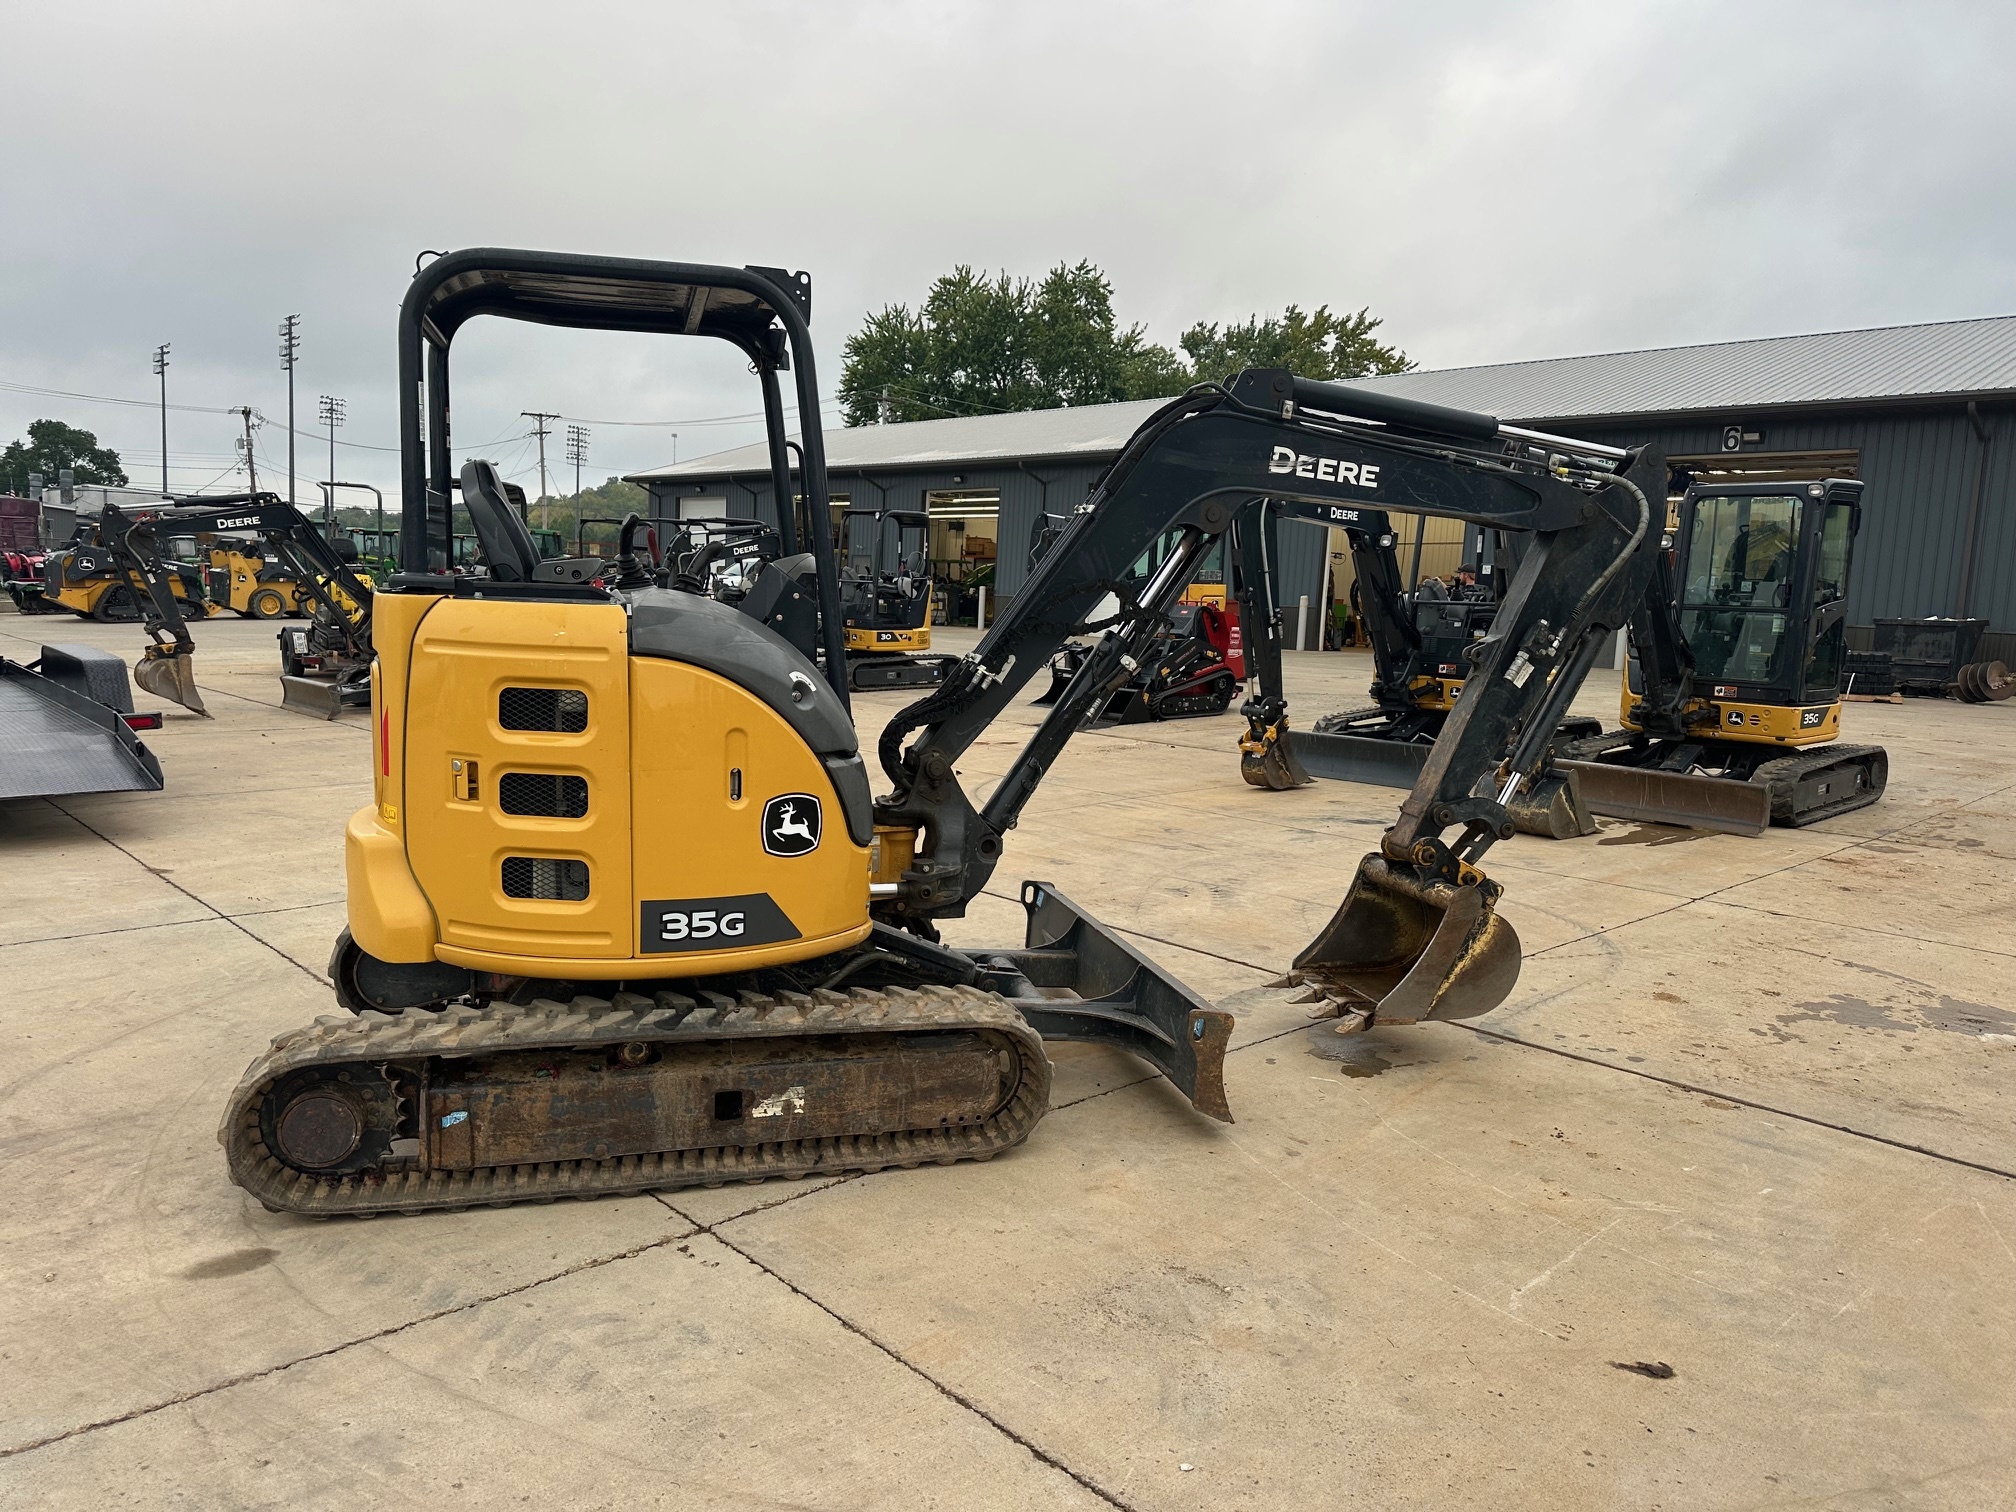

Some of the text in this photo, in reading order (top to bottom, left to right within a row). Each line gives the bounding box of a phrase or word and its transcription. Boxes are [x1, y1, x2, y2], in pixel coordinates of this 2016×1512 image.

[1723, 426, 1740, 450] 6
[1268, 445, 1380, 488] DEERE
[1330, 506, 1359, 521] DEERE
[216, 516, 261, 529] DEERE
[733, 544, 759, 556] DEERE
[1803, 713, 1819, 725] 35G
[661, 910, 745, 941] 35G
